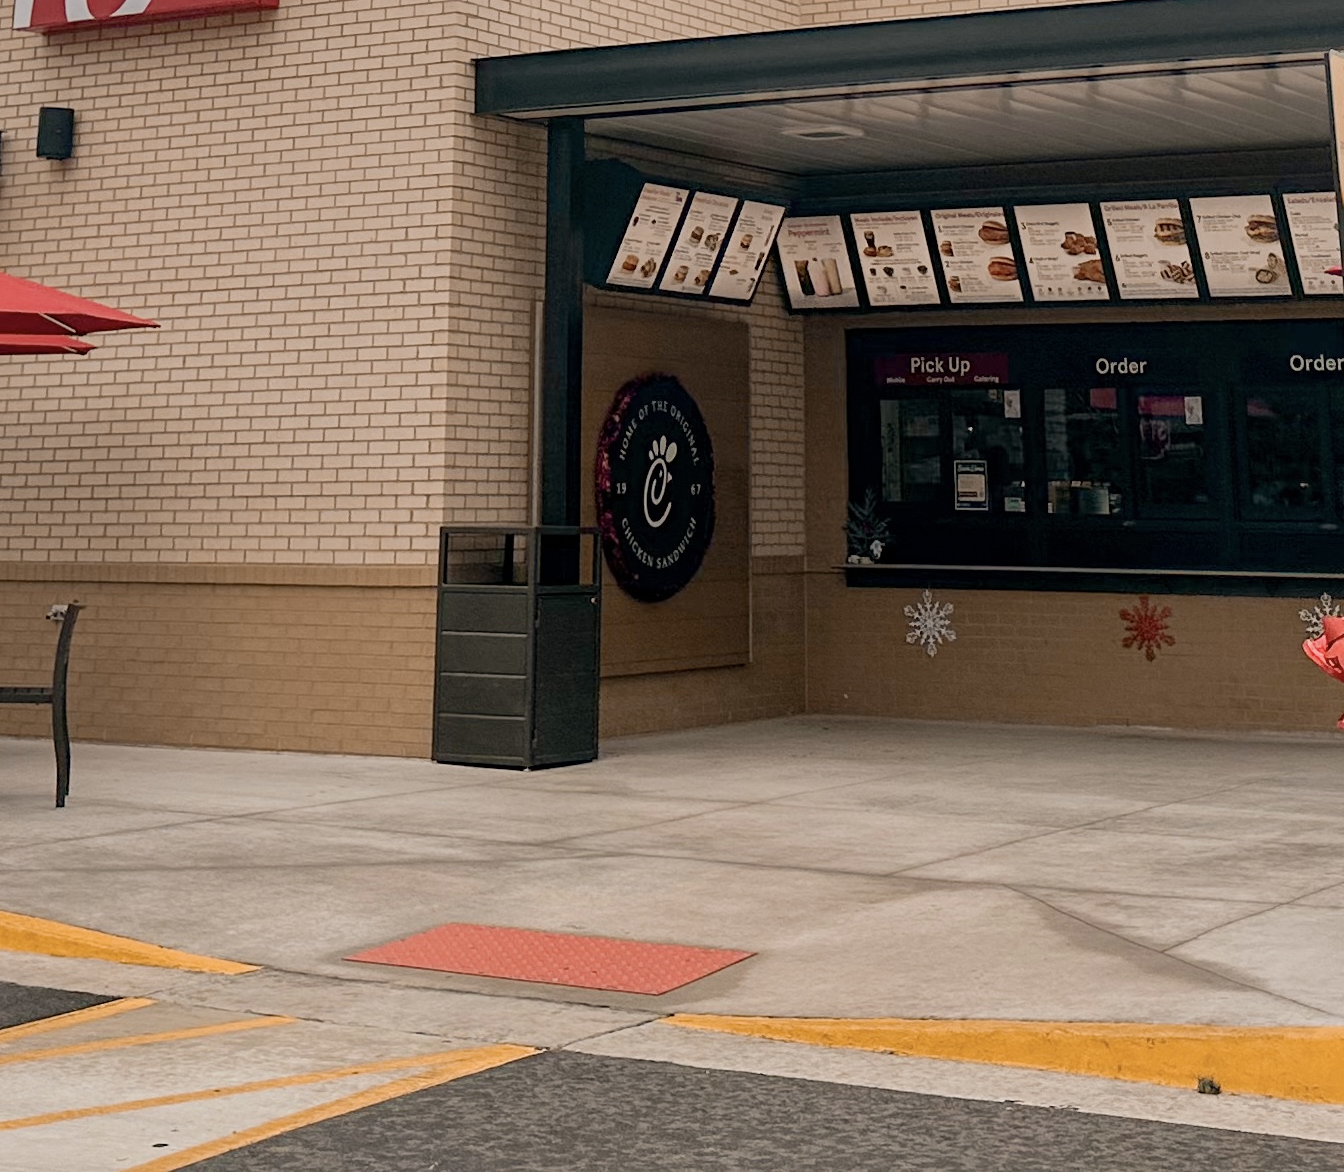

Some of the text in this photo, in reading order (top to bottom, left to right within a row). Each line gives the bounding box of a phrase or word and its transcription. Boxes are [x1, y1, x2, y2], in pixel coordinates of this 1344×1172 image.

[910, 357, 971, 377] Pick Up
[1095, 358, 1147, 375] Order
[1290, 354, 1344, 372] Order
[619, 400, 700, 466] HOME OF THE ORIGINAL
[616, 482, 627, 495] 19
[690, 483, 701, 495] 67
[621, 517, 697, 569] CHICKEN SANDWICH
